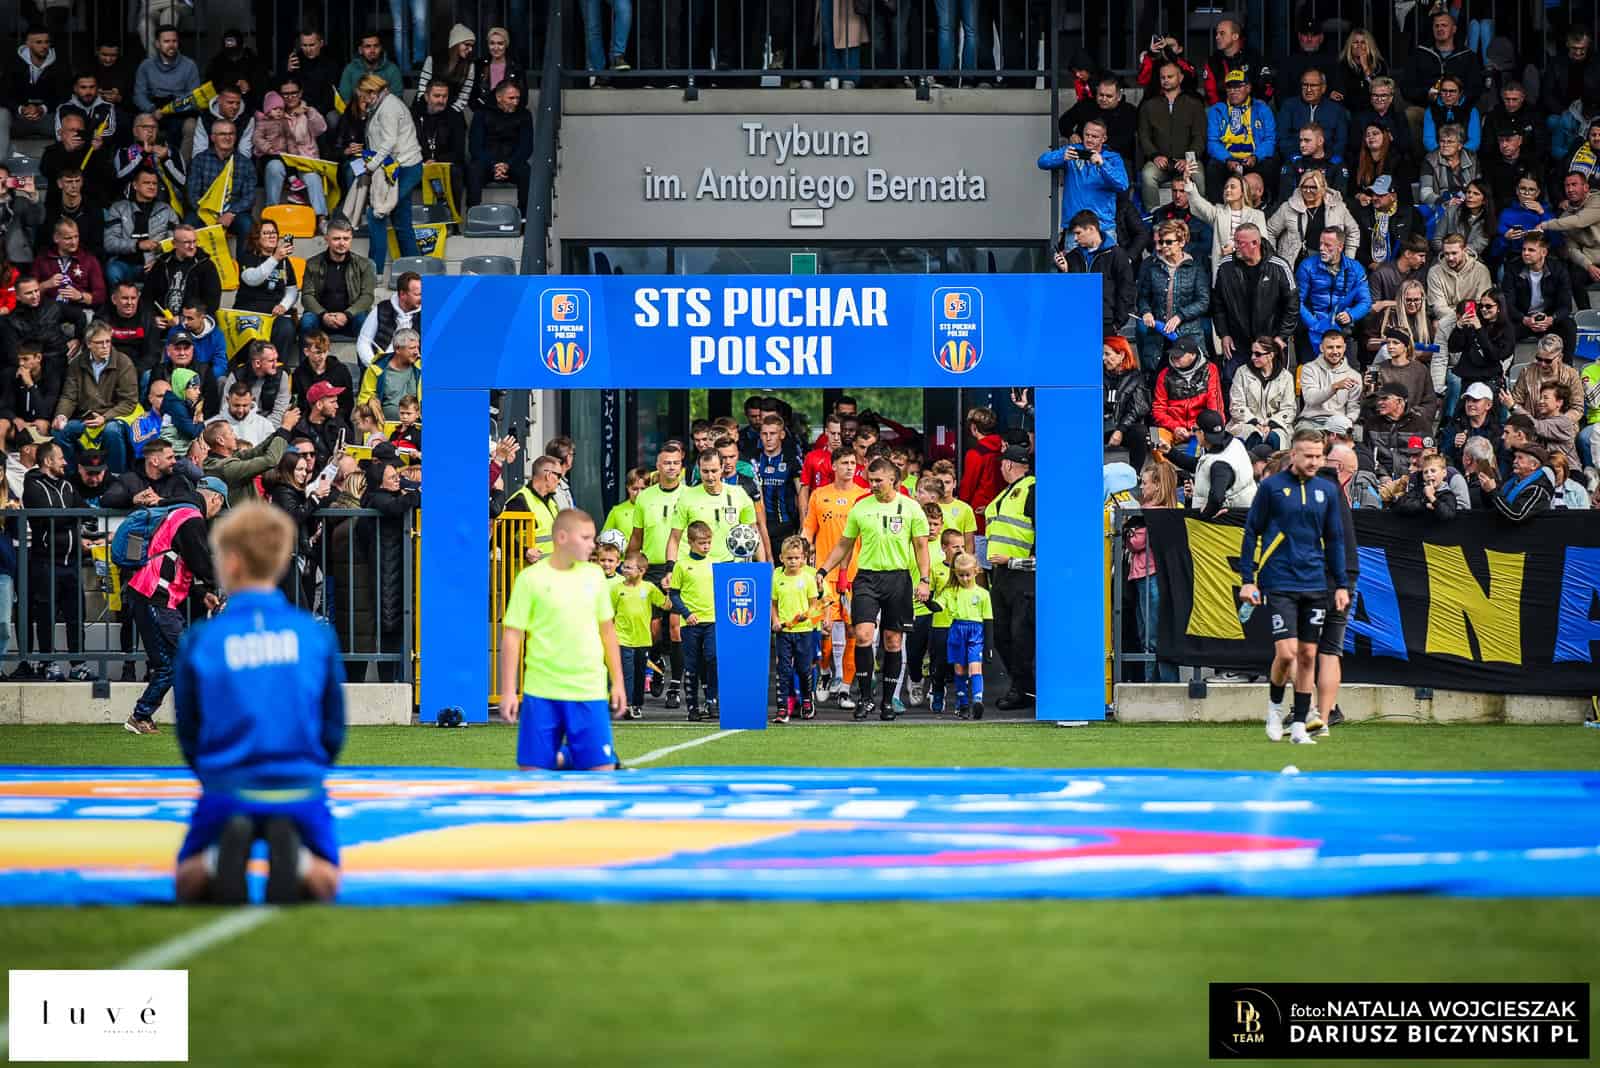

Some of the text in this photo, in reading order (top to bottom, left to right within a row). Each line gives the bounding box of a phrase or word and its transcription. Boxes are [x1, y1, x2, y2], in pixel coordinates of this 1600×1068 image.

[741, 121, 870, 164] Trybuna
[644, 168, 987, 208] im. Antoniego Bernata
[557, 302, 574, 313] STS
[634, 287, 888, 327] STS PUCHAR
[950, 300, 967, 312] STS
[690, 335, 832, 375] POLSKI
